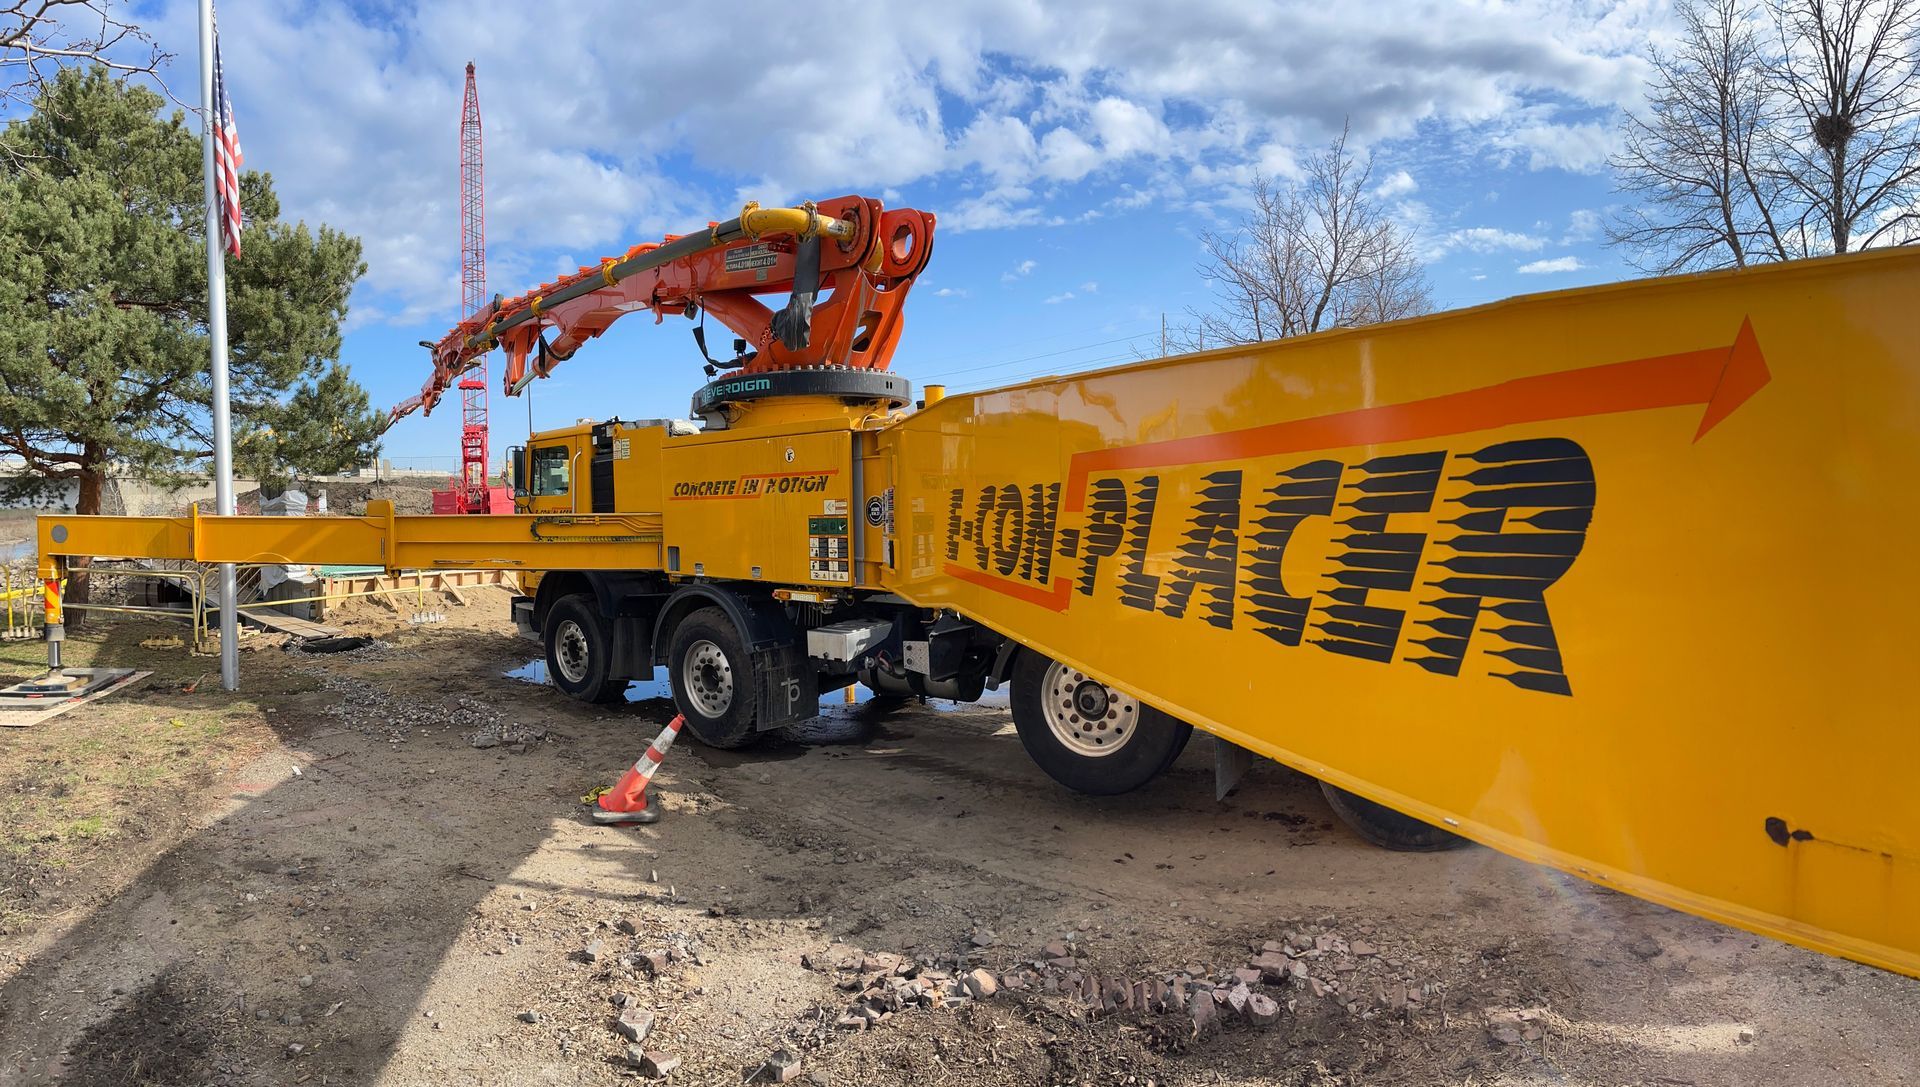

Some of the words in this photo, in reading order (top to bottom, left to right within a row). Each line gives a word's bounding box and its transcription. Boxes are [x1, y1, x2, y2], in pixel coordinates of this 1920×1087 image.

[674, 480, 736, 497] CONCRETE
[743, 479, 759, 495] IN
[766, 475, 829, 494] MOTION
